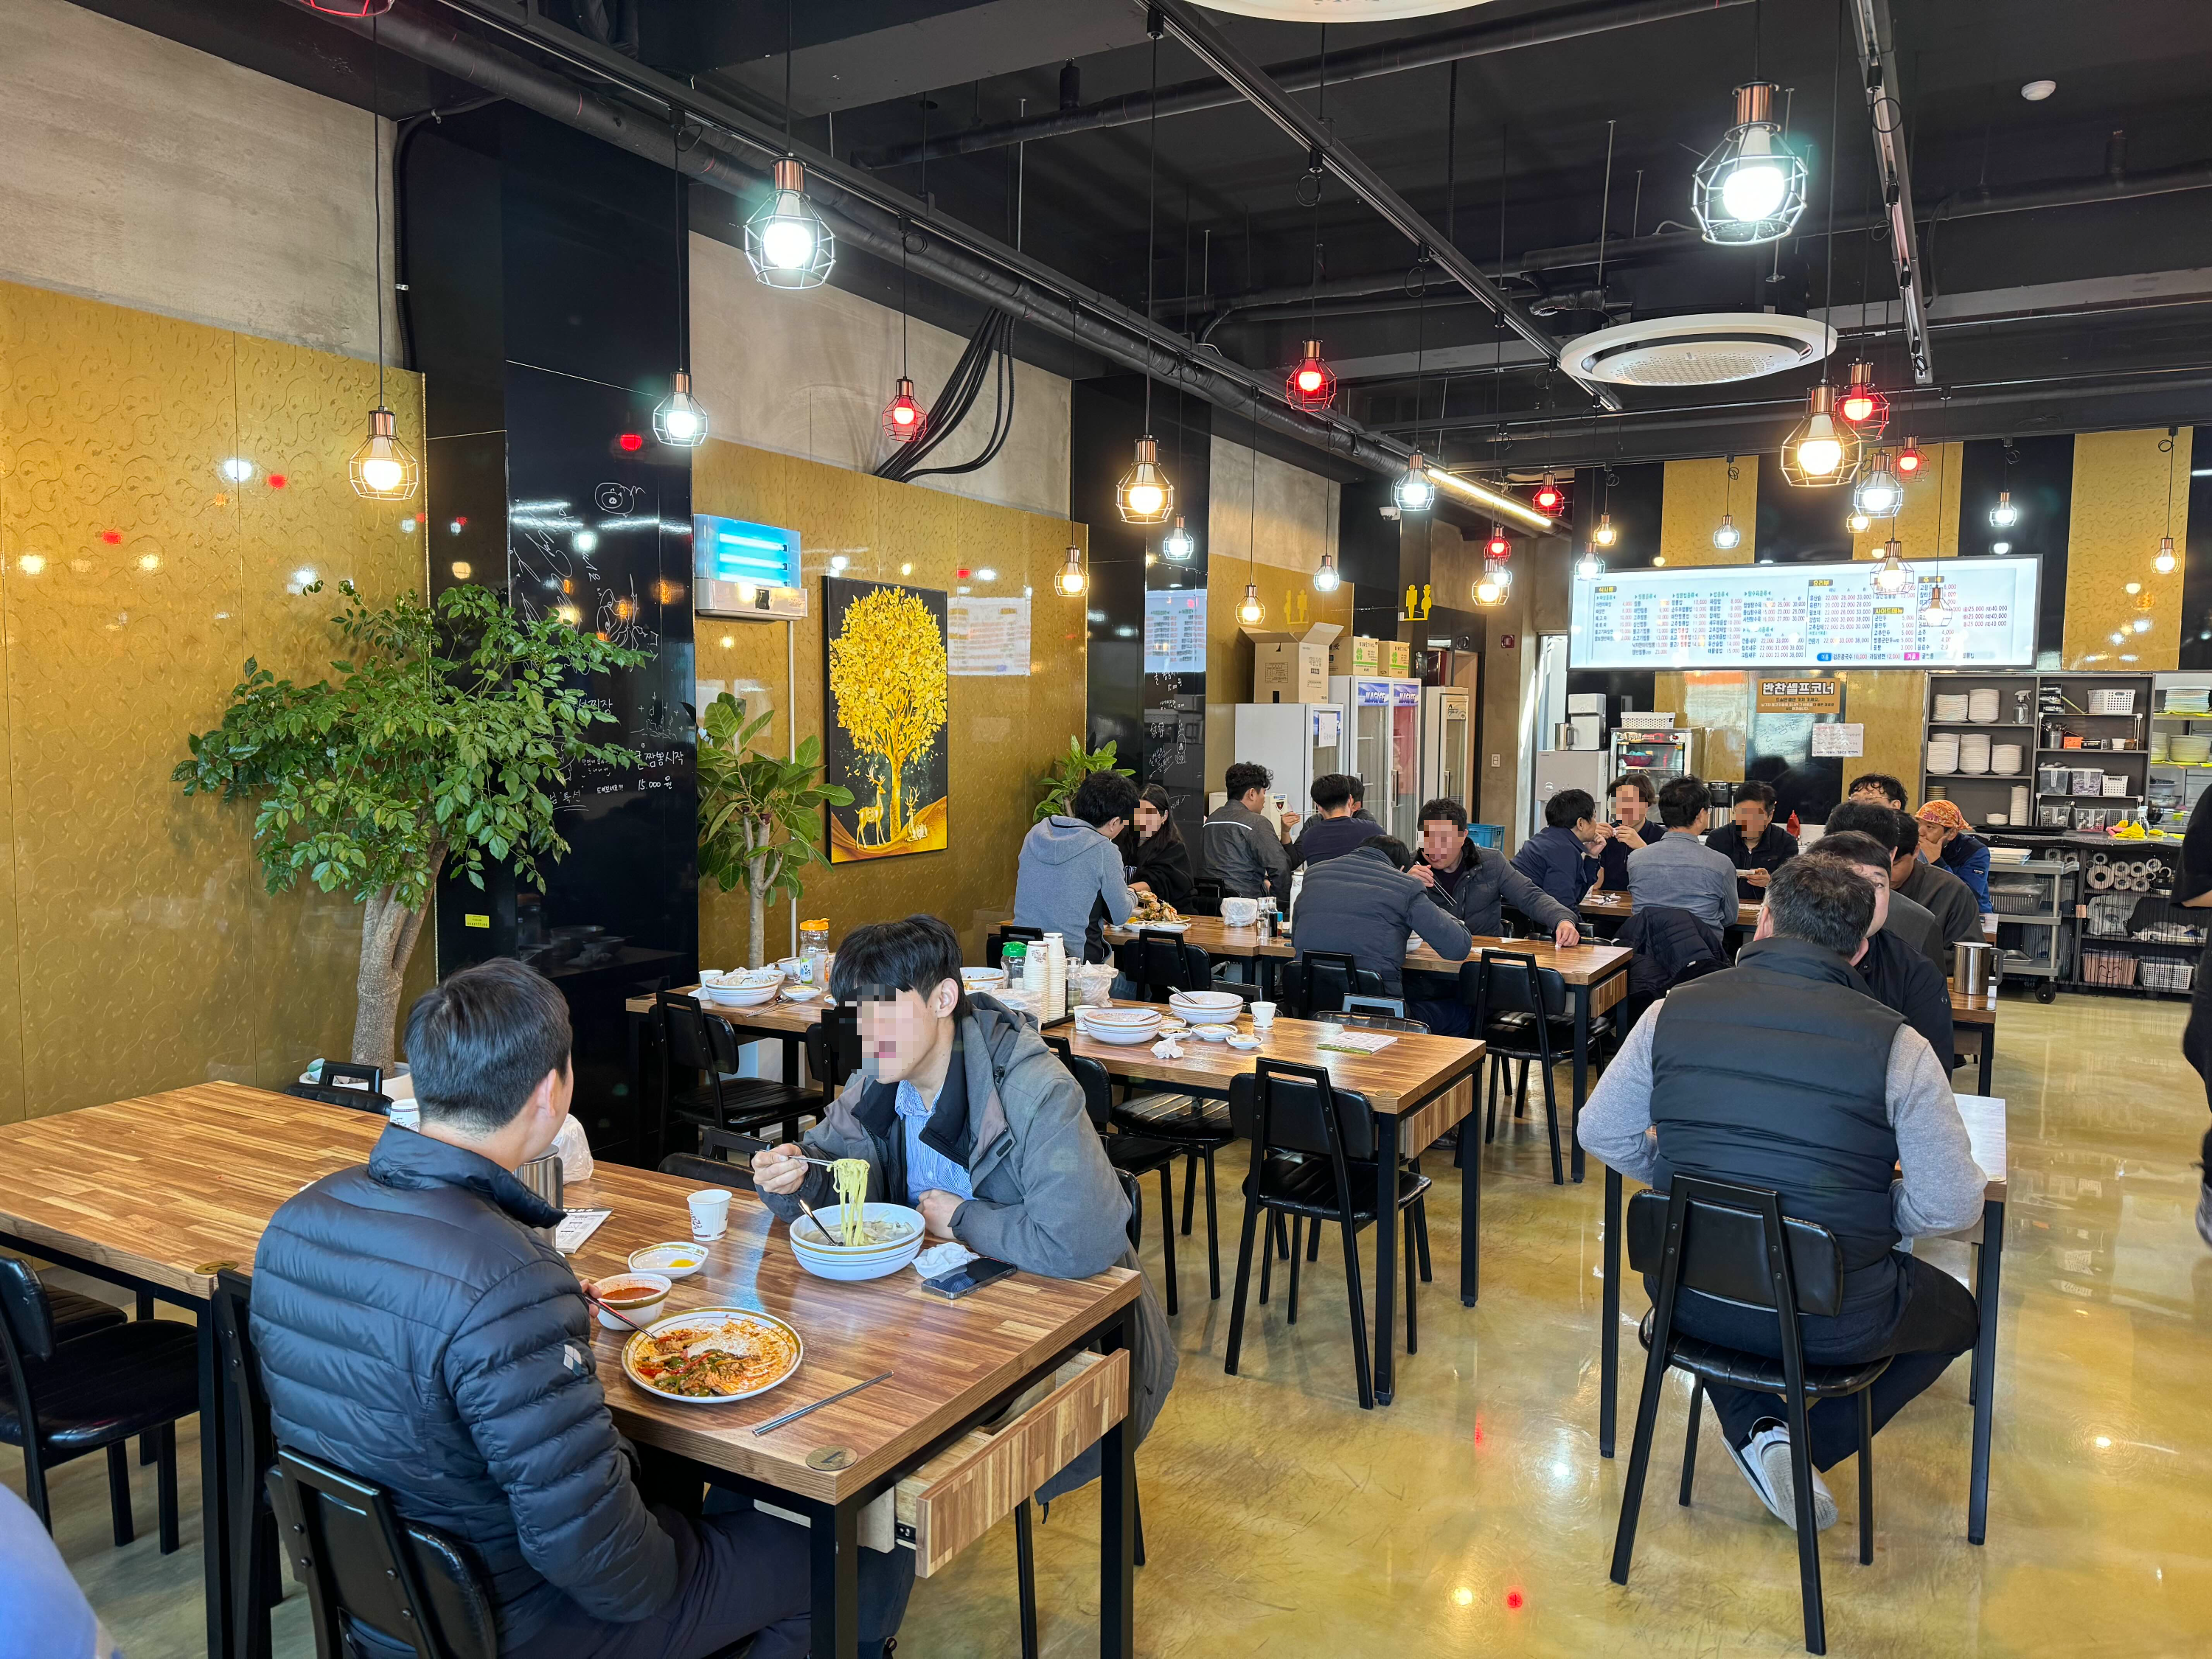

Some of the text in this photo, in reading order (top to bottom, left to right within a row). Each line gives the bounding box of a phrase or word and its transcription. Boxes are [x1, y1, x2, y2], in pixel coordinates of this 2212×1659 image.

[1762, 681, 1835, 695] 반찬셀프코너
[638, 775, 672, 791] 15.000 원
